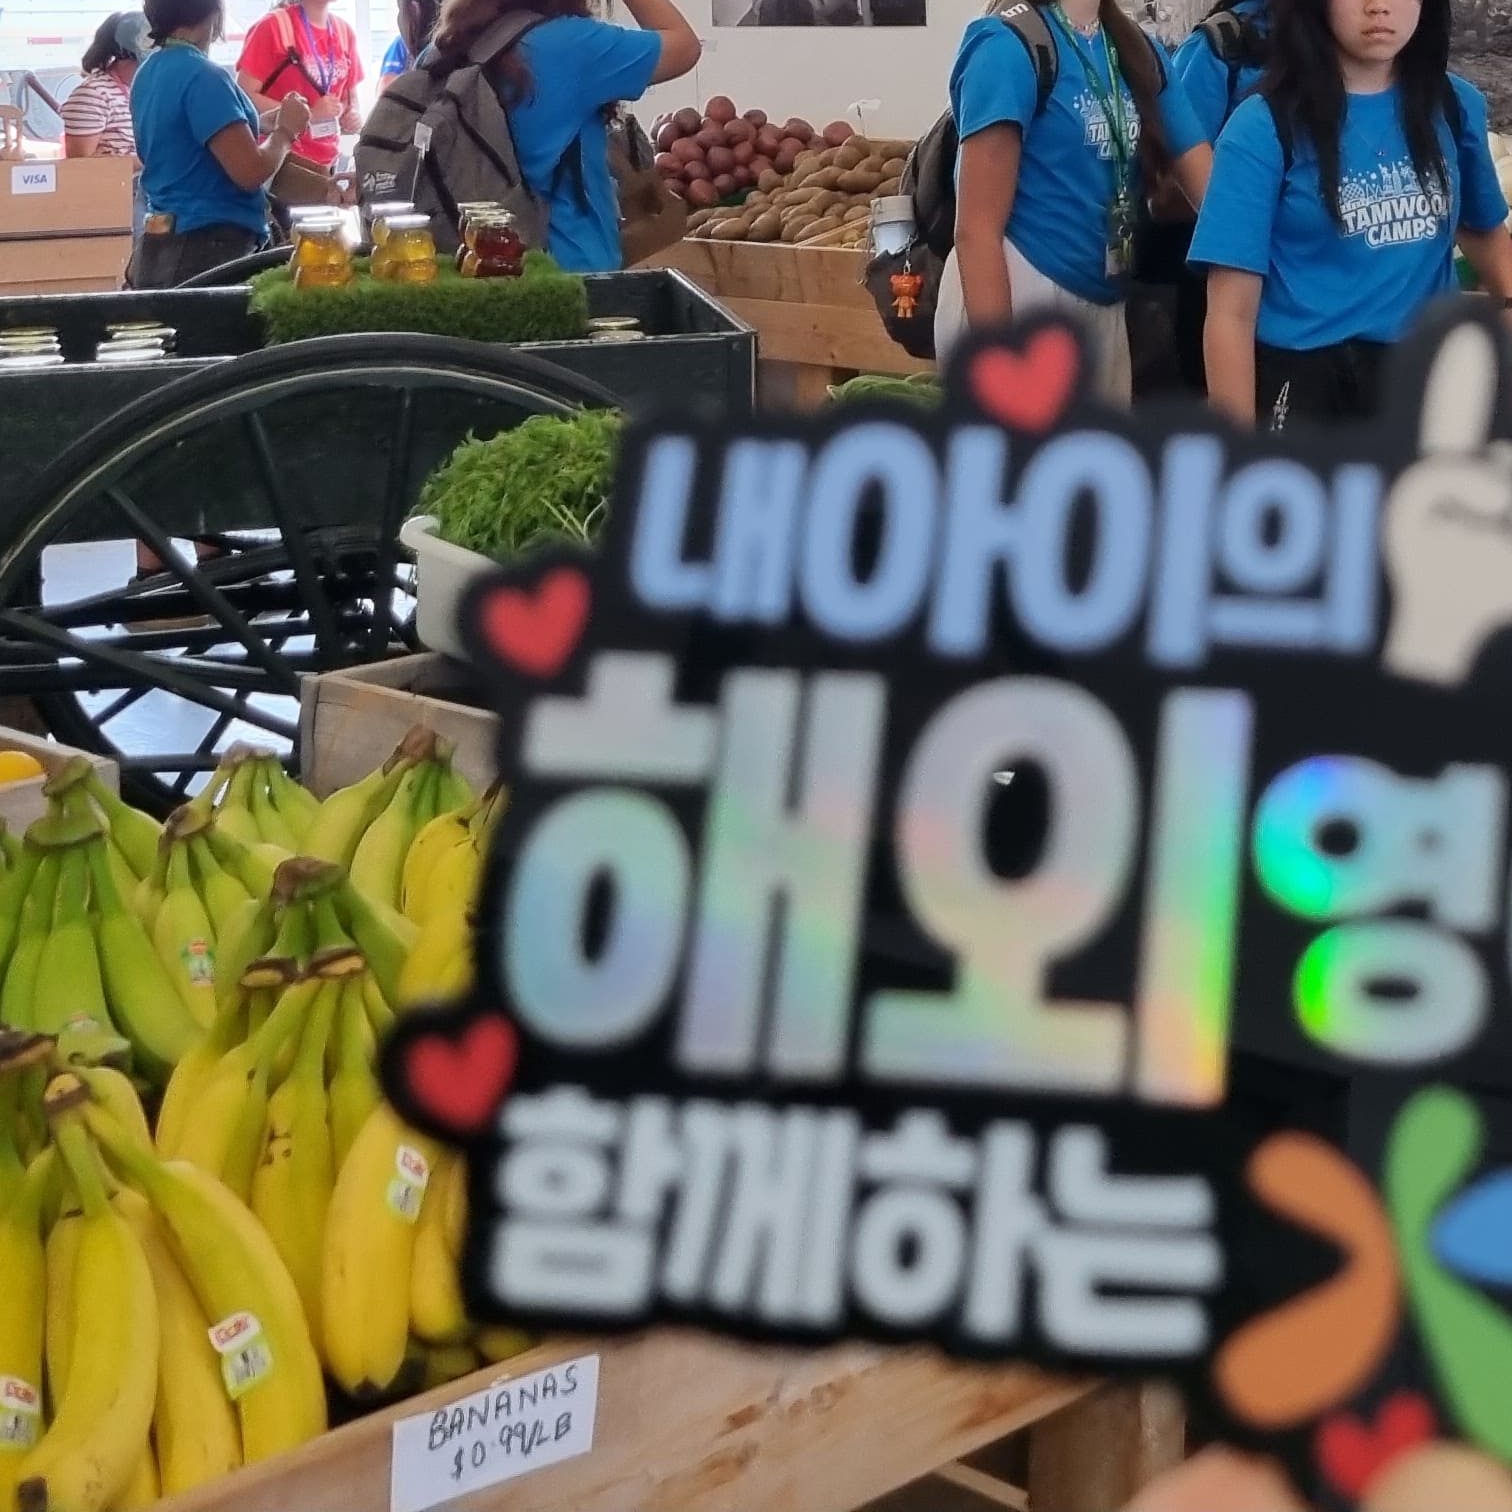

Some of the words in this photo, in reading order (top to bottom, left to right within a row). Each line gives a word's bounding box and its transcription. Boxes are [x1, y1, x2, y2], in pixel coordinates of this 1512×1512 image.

[22, 174, 47, 185] VISA
[1368, 216, 1437, 246] CAMPS
[489, 1087, 1222, 1357] 함께하는
[428, 1363, 577, 1451] BANANAS
